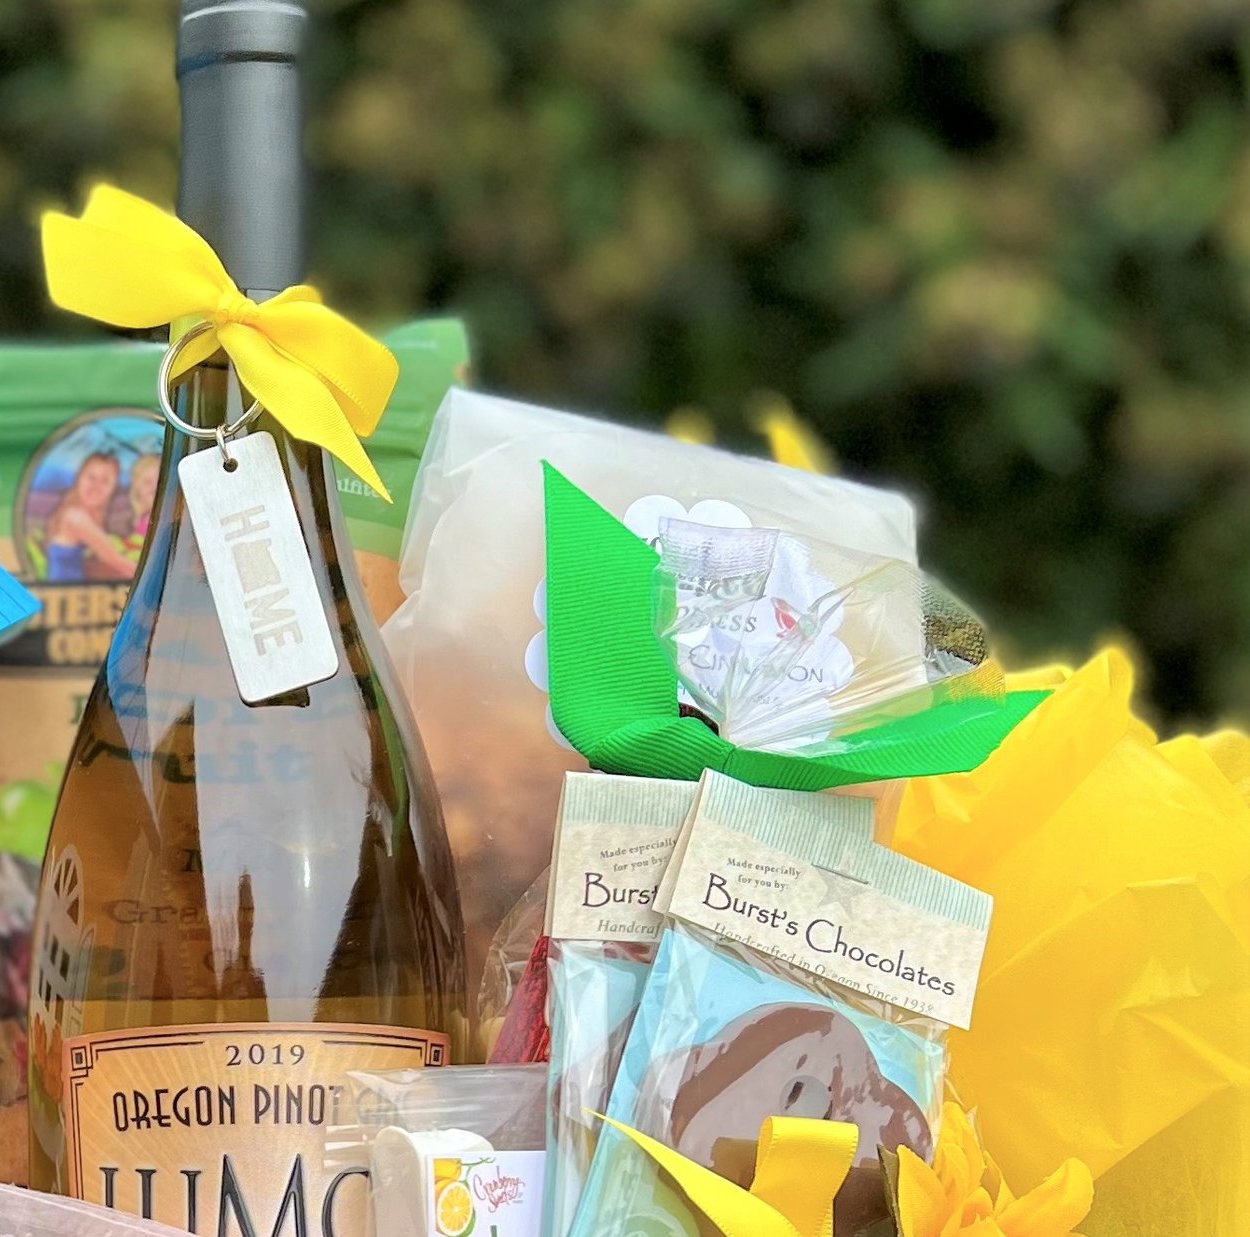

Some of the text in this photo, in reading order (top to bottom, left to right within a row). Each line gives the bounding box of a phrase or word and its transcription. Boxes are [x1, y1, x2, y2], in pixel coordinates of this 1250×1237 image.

[600, 848, 627, 860] Made
[613, 860, 628, 873] for
[631, 858, 650, 871] you
[727, 857, 801, 879] Made especially
[737, 874, 752, 886] for
[754, 877, 772, 889] you
[702, 873, 956, 997] Burst's Chocolates
[798, 955, 812, 971] in
[866, 982, 899, 1006] Since
[225, 1043, 306, 1068] 2019
[112, 1084, 236, 1132] OREGON
[253, 1083, 345, 1126] PINOT
